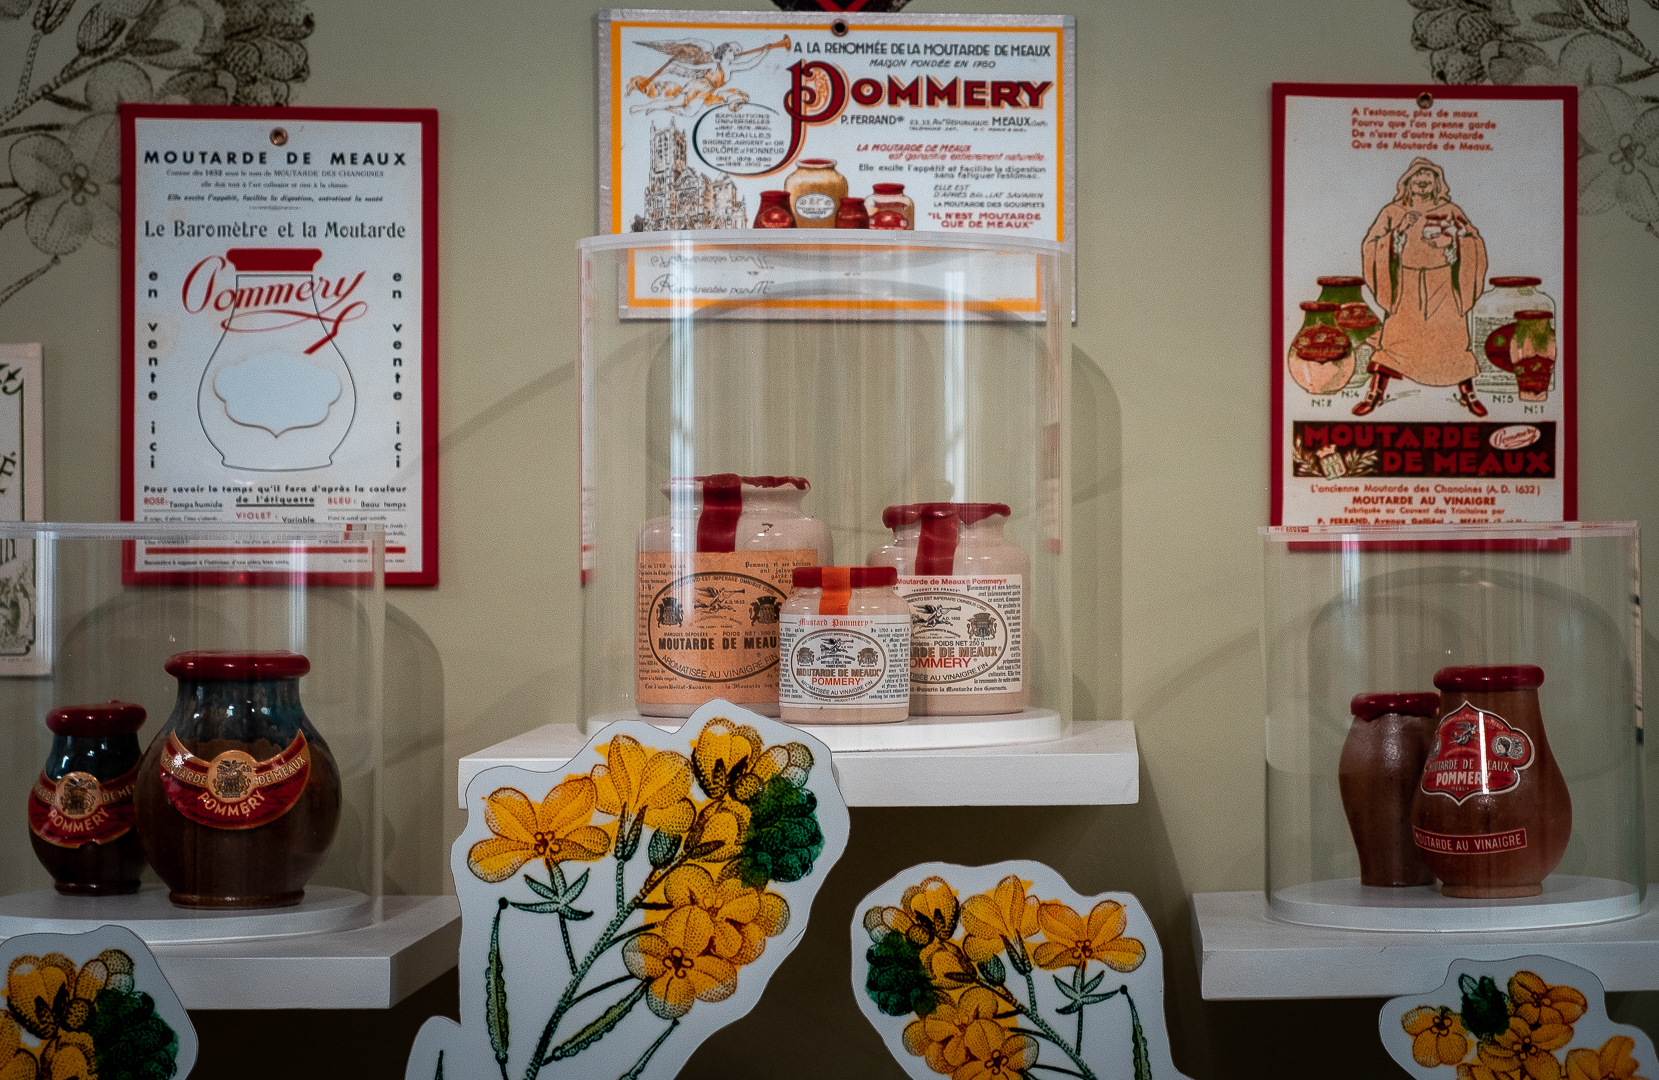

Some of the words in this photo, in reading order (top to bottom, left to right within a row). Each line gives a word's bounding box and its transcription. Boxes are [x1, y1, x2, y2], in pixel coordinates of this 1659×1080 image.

[794, 42, 802, 54] A
[807, 42, 820, 54] LA
[824, 40, 888, 54] RENOMMÉE
[891, 44, 905, 54] DE
[907, 44, 920, 54] LA
[924, 44, 990, 56] MOUTARDE
[994, 45, 1008, 56] DE
[1010, 44, 1051, 56] MEAUX
[869, 59, 906, 67] MAISON
[910, 59, 950, 67] FONDÉE
[954, 60, 968, 68] EN
[973, 60, 996, 68] 1760
[783, 58, 1053, 127] POMMERY
[1352, 108, 1360, 116] A
[1413, 109, 1432, 118] plus
[1436, 109, 1448, 118] de
[992, 116, 1030, 126] MEAUX
[1352, 118, 1384, 127] Pourvu
[1388, 120, 1406, 129] que
[1410, 119, 1427, 127] l'on
[1431, 121, 1464, 130] prenne
[1468, 121, 1496, 130] garde
[1352, 129, 1365, 137] De
[1439, 131, 1484, 140] Moutarde
[856, 144, 868, 152] LA
[871, 144, 924, 152] MOUTARDE
[924, 144, 938, 152] DE
[940, 144, 972, 152] MEAUX
[1352, 140, 1372, 149] Que
[1376, 140, 1388, 149] de
[1393, 141, 1438, 150] Moutarde
[1443, 142, 1455, 150] de
[1459, 143, 1494, 151] Meaux.
[144, 151, 267, 164] MOUTARDE
[286, 152, 310, 164] DE
[330, 152, 406, 166] MEAUX
[888, 152, 903, 160] est
[859, 164, 874, 172] Elle
[878, 164, 903, 172] excite
[948, 164, 956, 172] et
[1005, 166, 1046, 174] digestion
[945, 212, 974, 220] N'EST
[979, 212, 1041, 220] MOUTARDE
[145, 220, 165, 237] Le
[174, 220, 267, 237] Baromètre
[278, 222, 294, 238] et
[303, 222, 316, 238] la
[325, 222, 405, 238] Moutarde
[940, 220, 964, 228] QUE
[968, 220, 983, 228] DE
[182, 255, 367, 345] Pommery
[1304, 424, 1480, 449] MOUTARDE
[1383, 452, 1423, 472] DE
[1433, 452, 1550, 474] MEAUX
[144, 485, 168, 493] Pour
[173, 485, 204, 493] savoir
[209, 485, 218, 493] le
[222, 485, 252, 494] temps
[258, 485, 280, 494] qu'il
[312, 485, 350, 494] d'après
[1364, 484, 1409, 493] Moutarde
[1413, 484, 1429, 493] des
[1434, 484, 1482, 493] Chanoines
[384, 501, 406, 509] temps
[1352, 496, 1413, 504] MOUTARDE
[1420, 496, 1436, 504] AU
[1443, 497, 1496, 505] VINAIGRE
[799, 618, 828, 626] Mustard
[659, 638, 714, 650] MOUTARDE
[722, 638, 736, 649] DE
[744, 637, 780, 649] MEAU
[910, 647, 935, 657] ARDE
[940, 647, 955, 657] DE
[662, 654, 706, 678] AROMATISÉE
[709, 670, 720, 678] AU
[723, 662, 764, 678] VINAIGRE
[765, 652, 778, 663] FIN
[797, 669, 835, 677] MOUTARDE
[838, 669, 848, 677] DE
[942, 668, 977, 680] VINAIGRE
[978, 662, 988, 671] FIN
[840, 685, 864, 694] VINAIGRE
[258, 774, 271, 785] DE
[273, 755, 305, 780] MEAUX
[1463, 760, 1474, 769] DE
[1479, 761, 1509, 772] EAUX
[198, 791, 265, 817] POMMERY
[48, 807, 109, 832] POMMERY
[1456, 840, 1469, 850] AU
[1474, 833, 1521, 850] VINAIGRE
